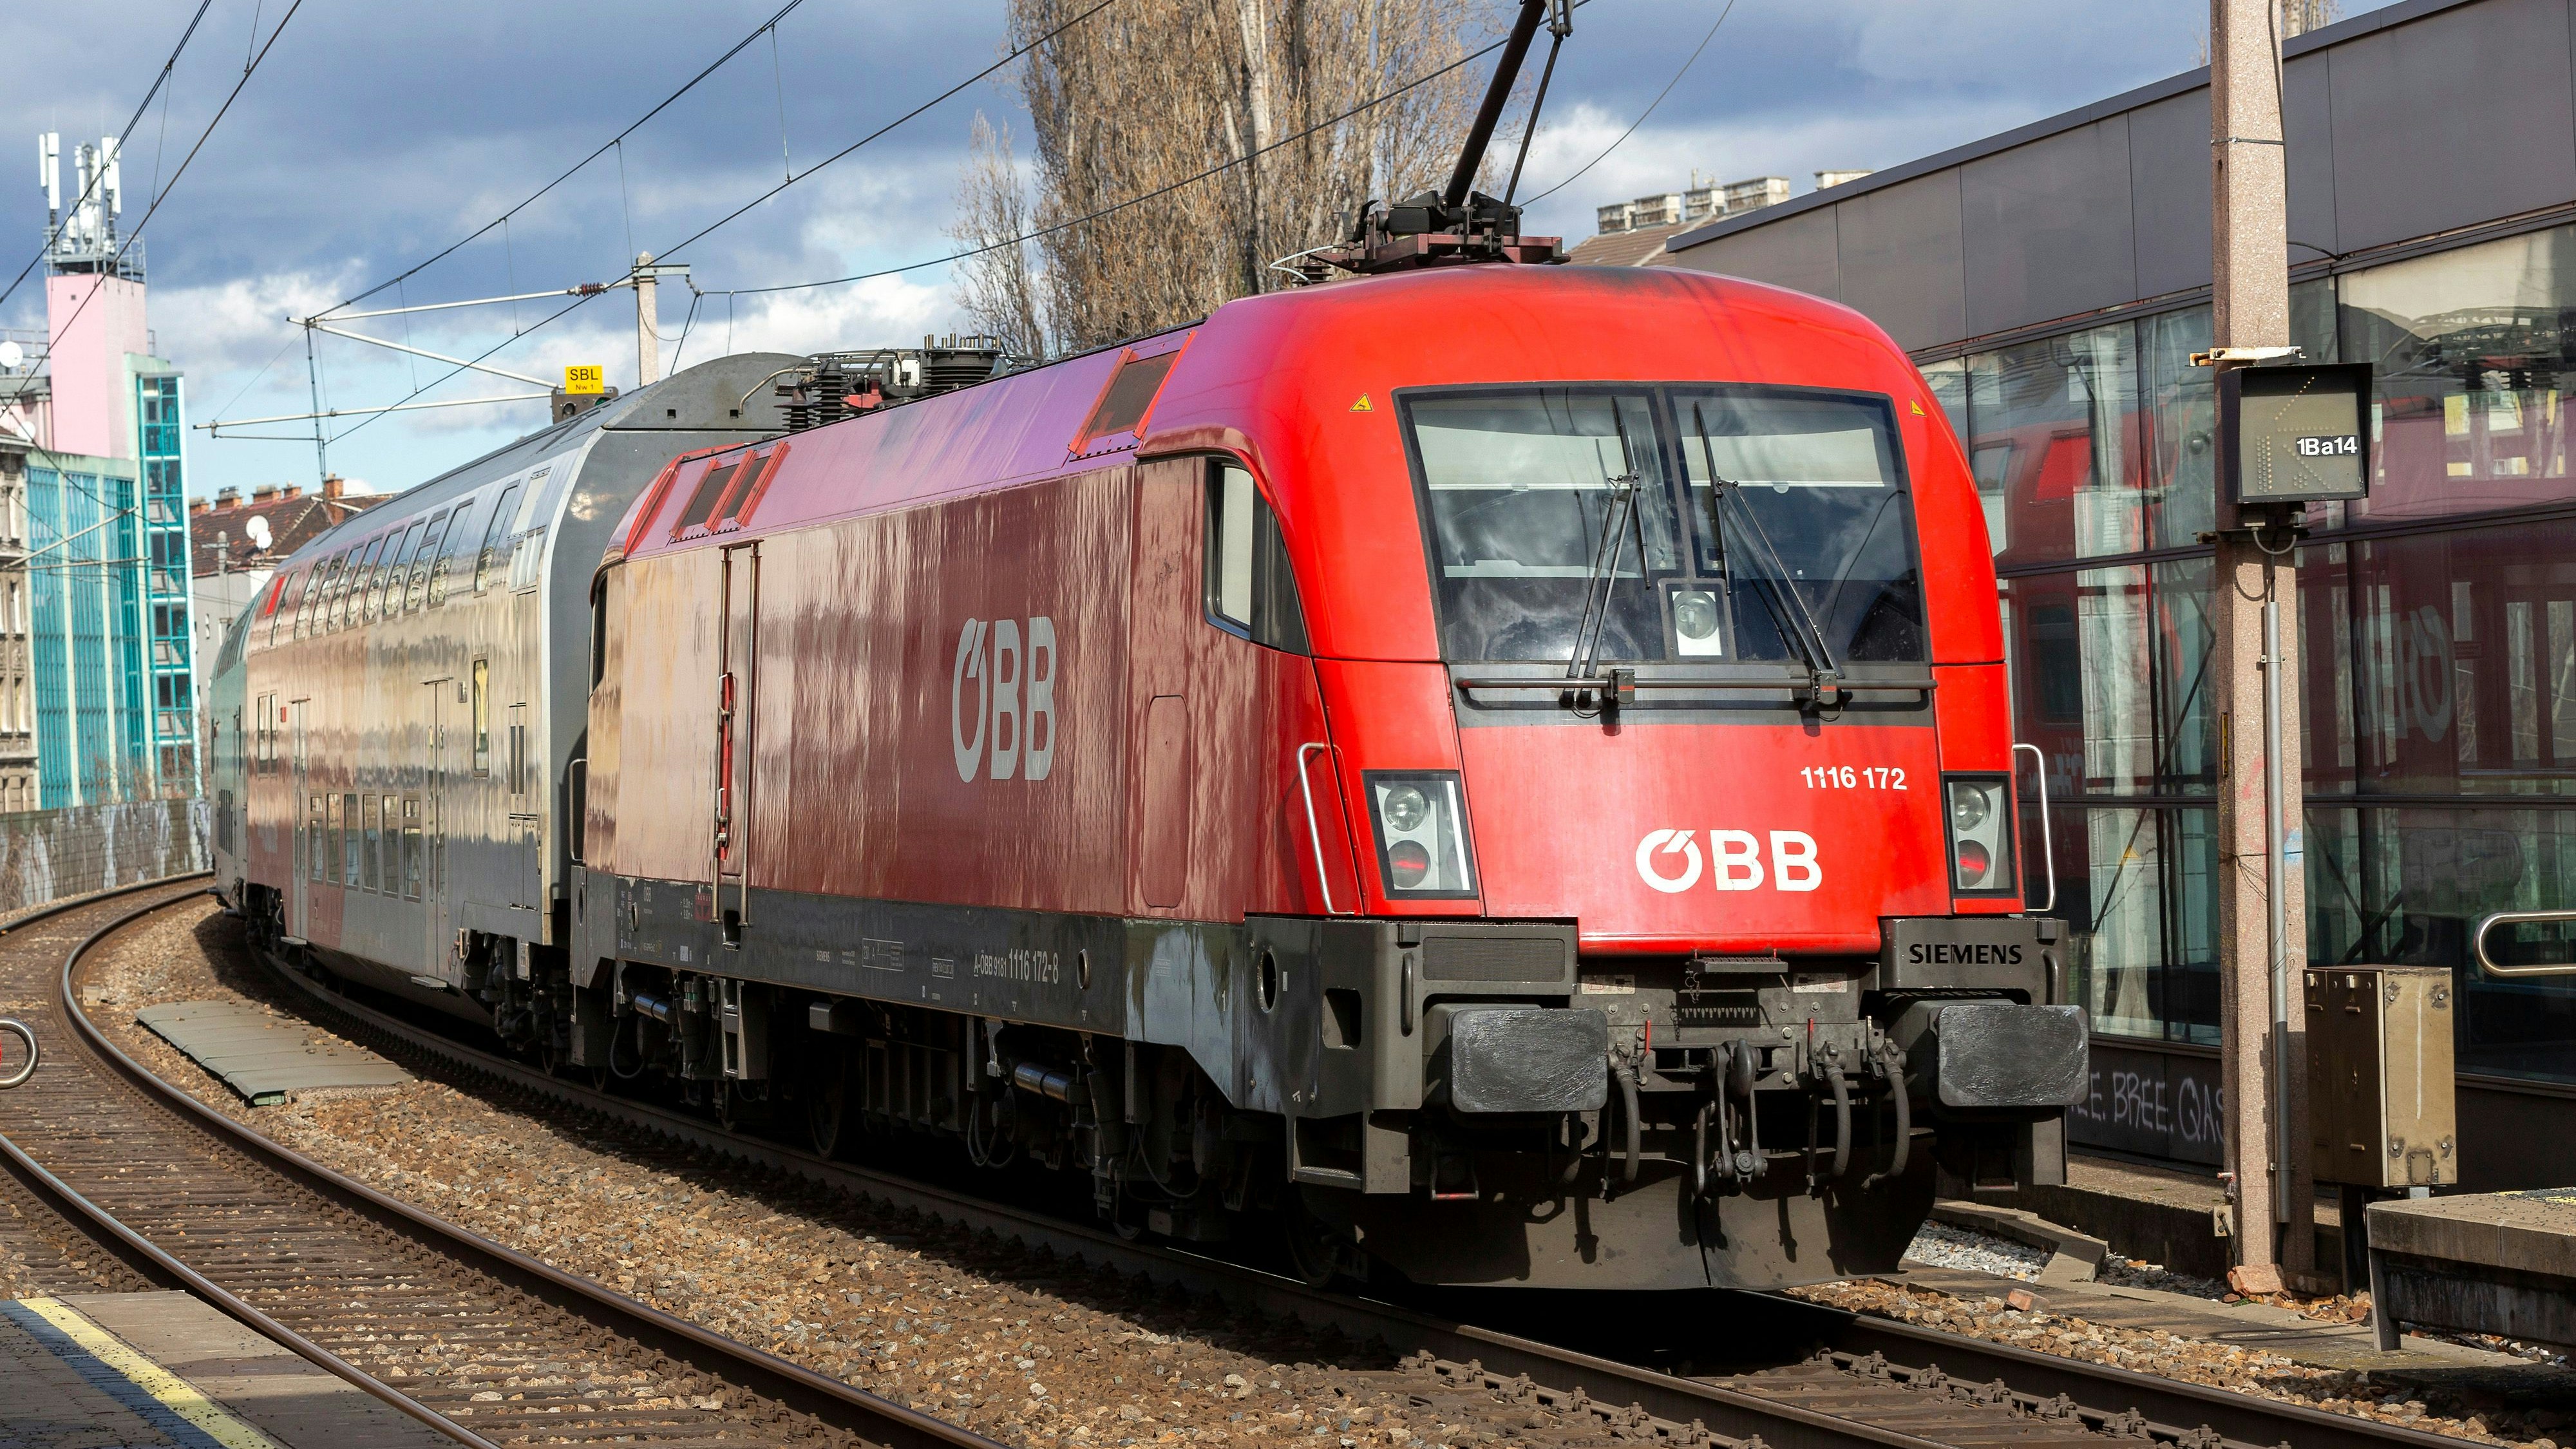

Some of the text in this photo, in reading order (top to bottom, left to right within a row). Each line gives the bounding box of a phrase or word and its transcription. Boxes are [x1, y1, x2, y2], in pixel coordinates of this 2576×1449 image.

[570, 368, 598, 381] SBL
[2297, 437, 2358, 456] 1Ba14
[952, 616, 1056, 783] ÖBB
[1801, 766, 1908, 790] 1116 172
[1636, 829, 1822, 893] ÖBB
[1009, 948, 1029, 981] 1116
[1033, 951, 1058, 984] 172-8
[1909, 943, 2022, 965] SIEMENS
